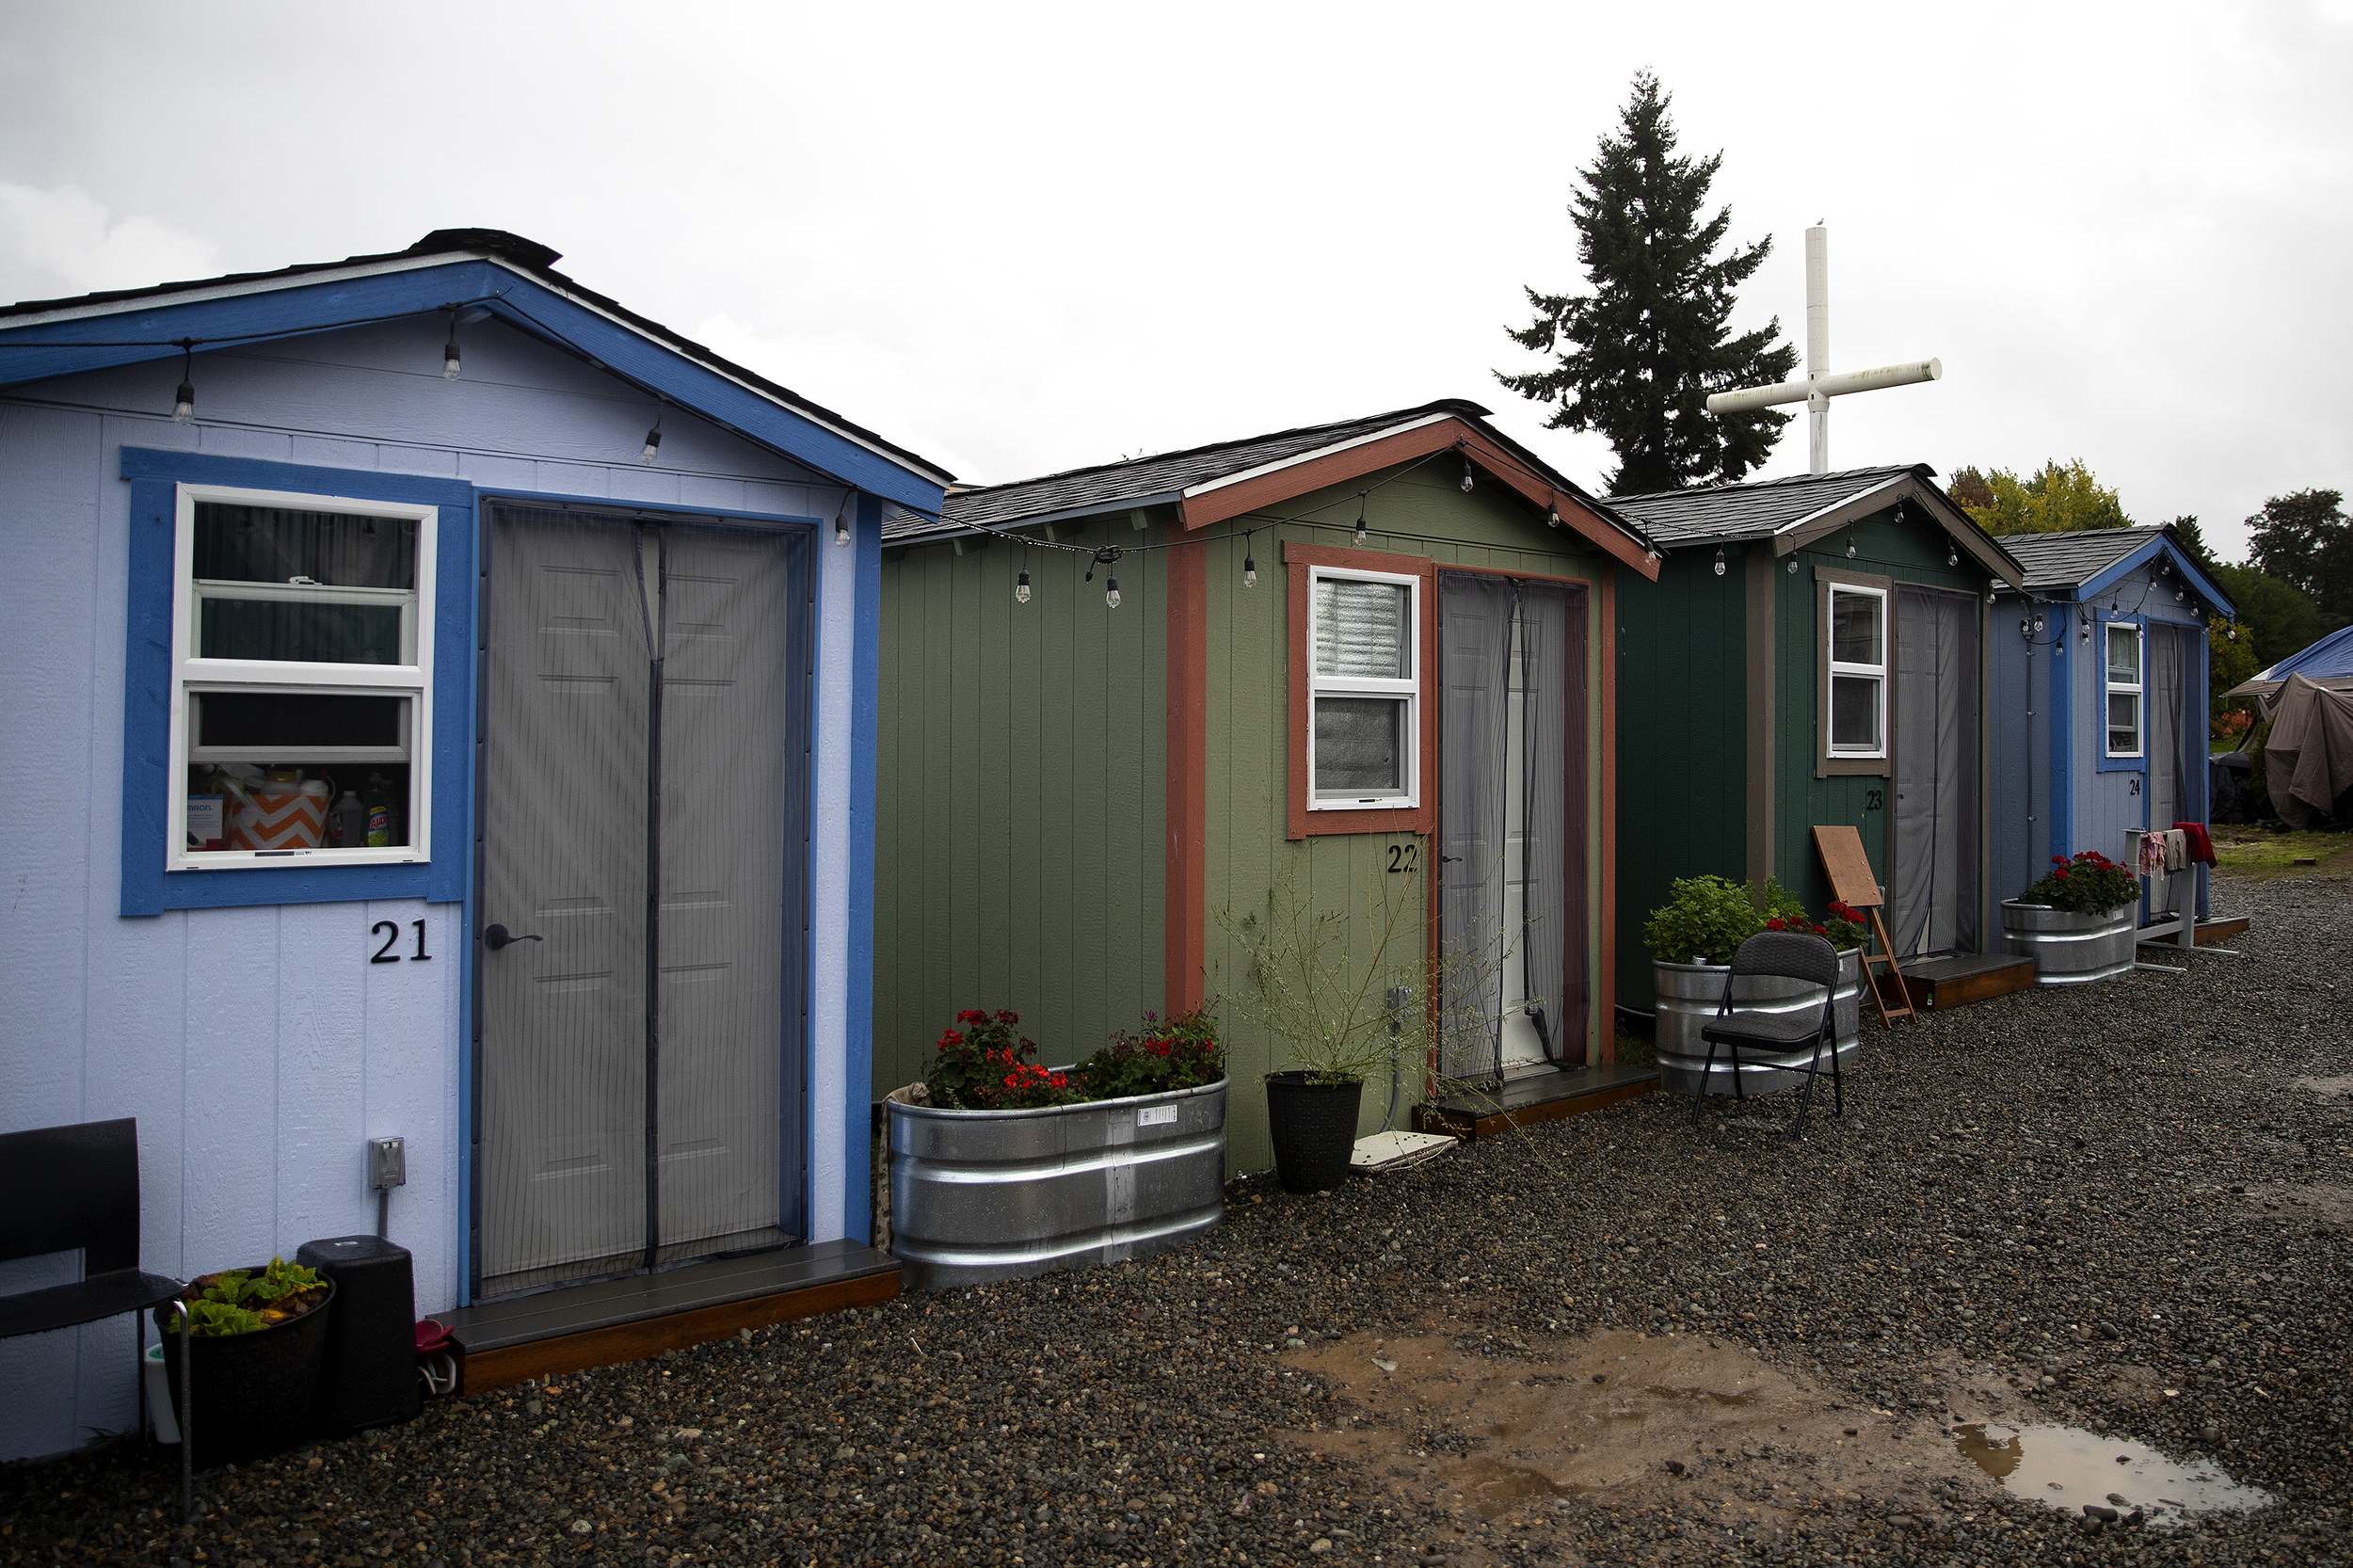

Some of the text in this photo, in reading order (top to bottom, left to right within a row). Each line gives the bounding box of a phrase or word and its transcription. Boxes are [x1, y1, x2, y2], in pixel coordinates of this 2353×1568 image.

[2130, 779, 2140, 795] 24
[1867, 790, 1882, 810] 23
[370, 815, 387, 829] AJAX
[1388, 844, 1417, 873] 22
[371, 919, 433, 964] 21
